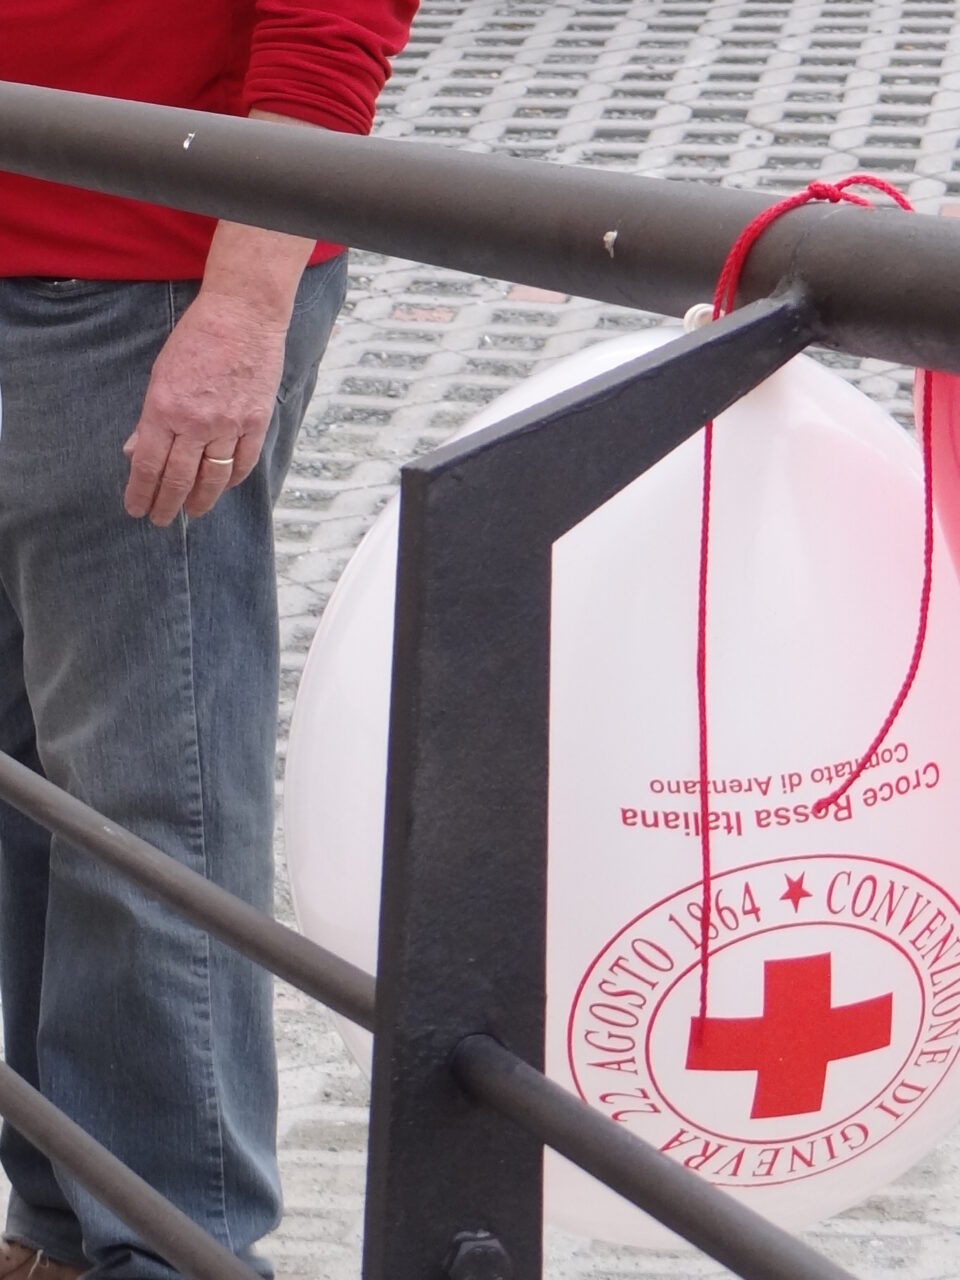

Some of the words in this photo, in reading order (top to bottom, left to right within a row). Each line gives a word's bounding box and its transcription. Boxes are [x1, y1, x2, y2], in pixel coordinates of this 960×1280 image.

[781, 772, 803, 794] di
[861, 762, 940, 807] Croce
[584, 938, 675, 1075] AGOSTO
[599, 1087, 662, 1122] 22
[875, 1079, 928, 1120] DI
[659, 1121, 870, 1178] GINEVRA
